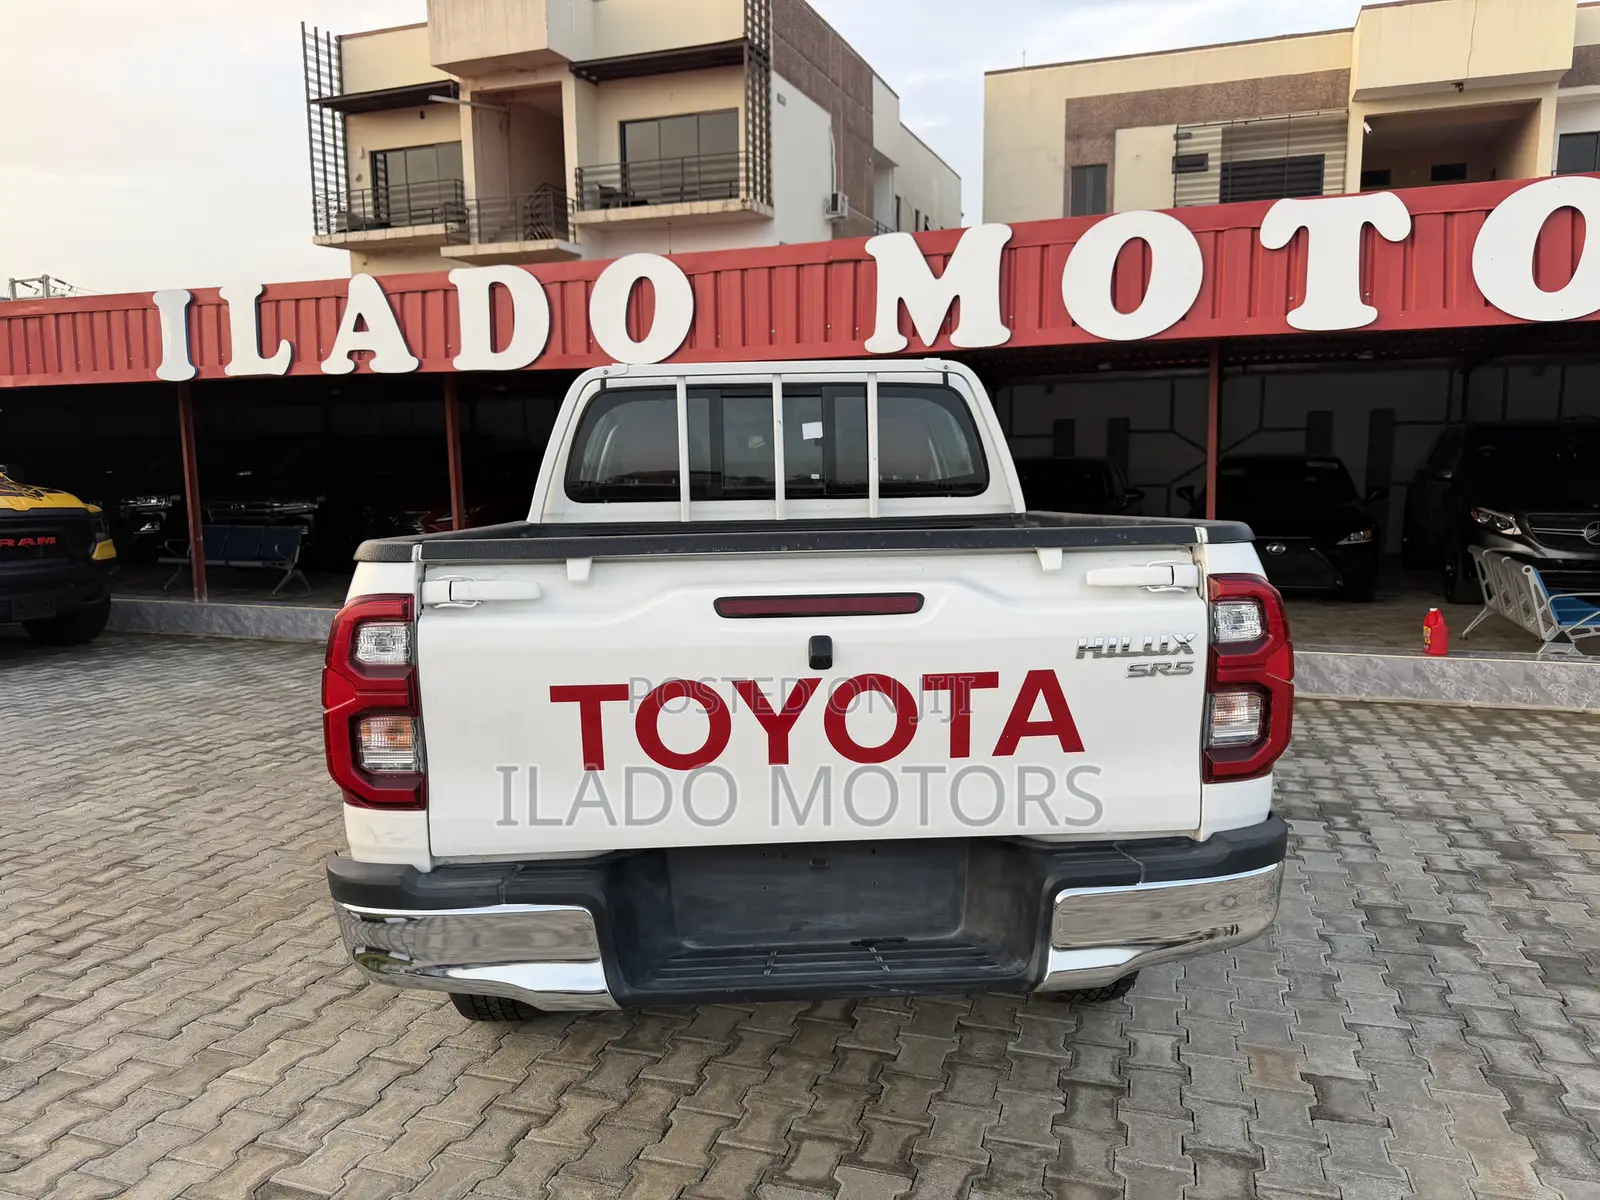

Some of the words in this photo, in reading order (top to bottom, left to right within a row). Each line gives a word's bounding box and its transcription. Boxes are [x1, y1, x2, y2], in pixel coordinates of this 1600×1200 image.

[152, 253, 695, 382] ILADO
[864, 175, 1600, 354] MOTO
[0, 537, 56, 546] RAM
[1076, 632, 1197, 659] HILUX
[1125, 660, 1195, 678] SR5
[549, 669, 1085, 771] TOYOTA
